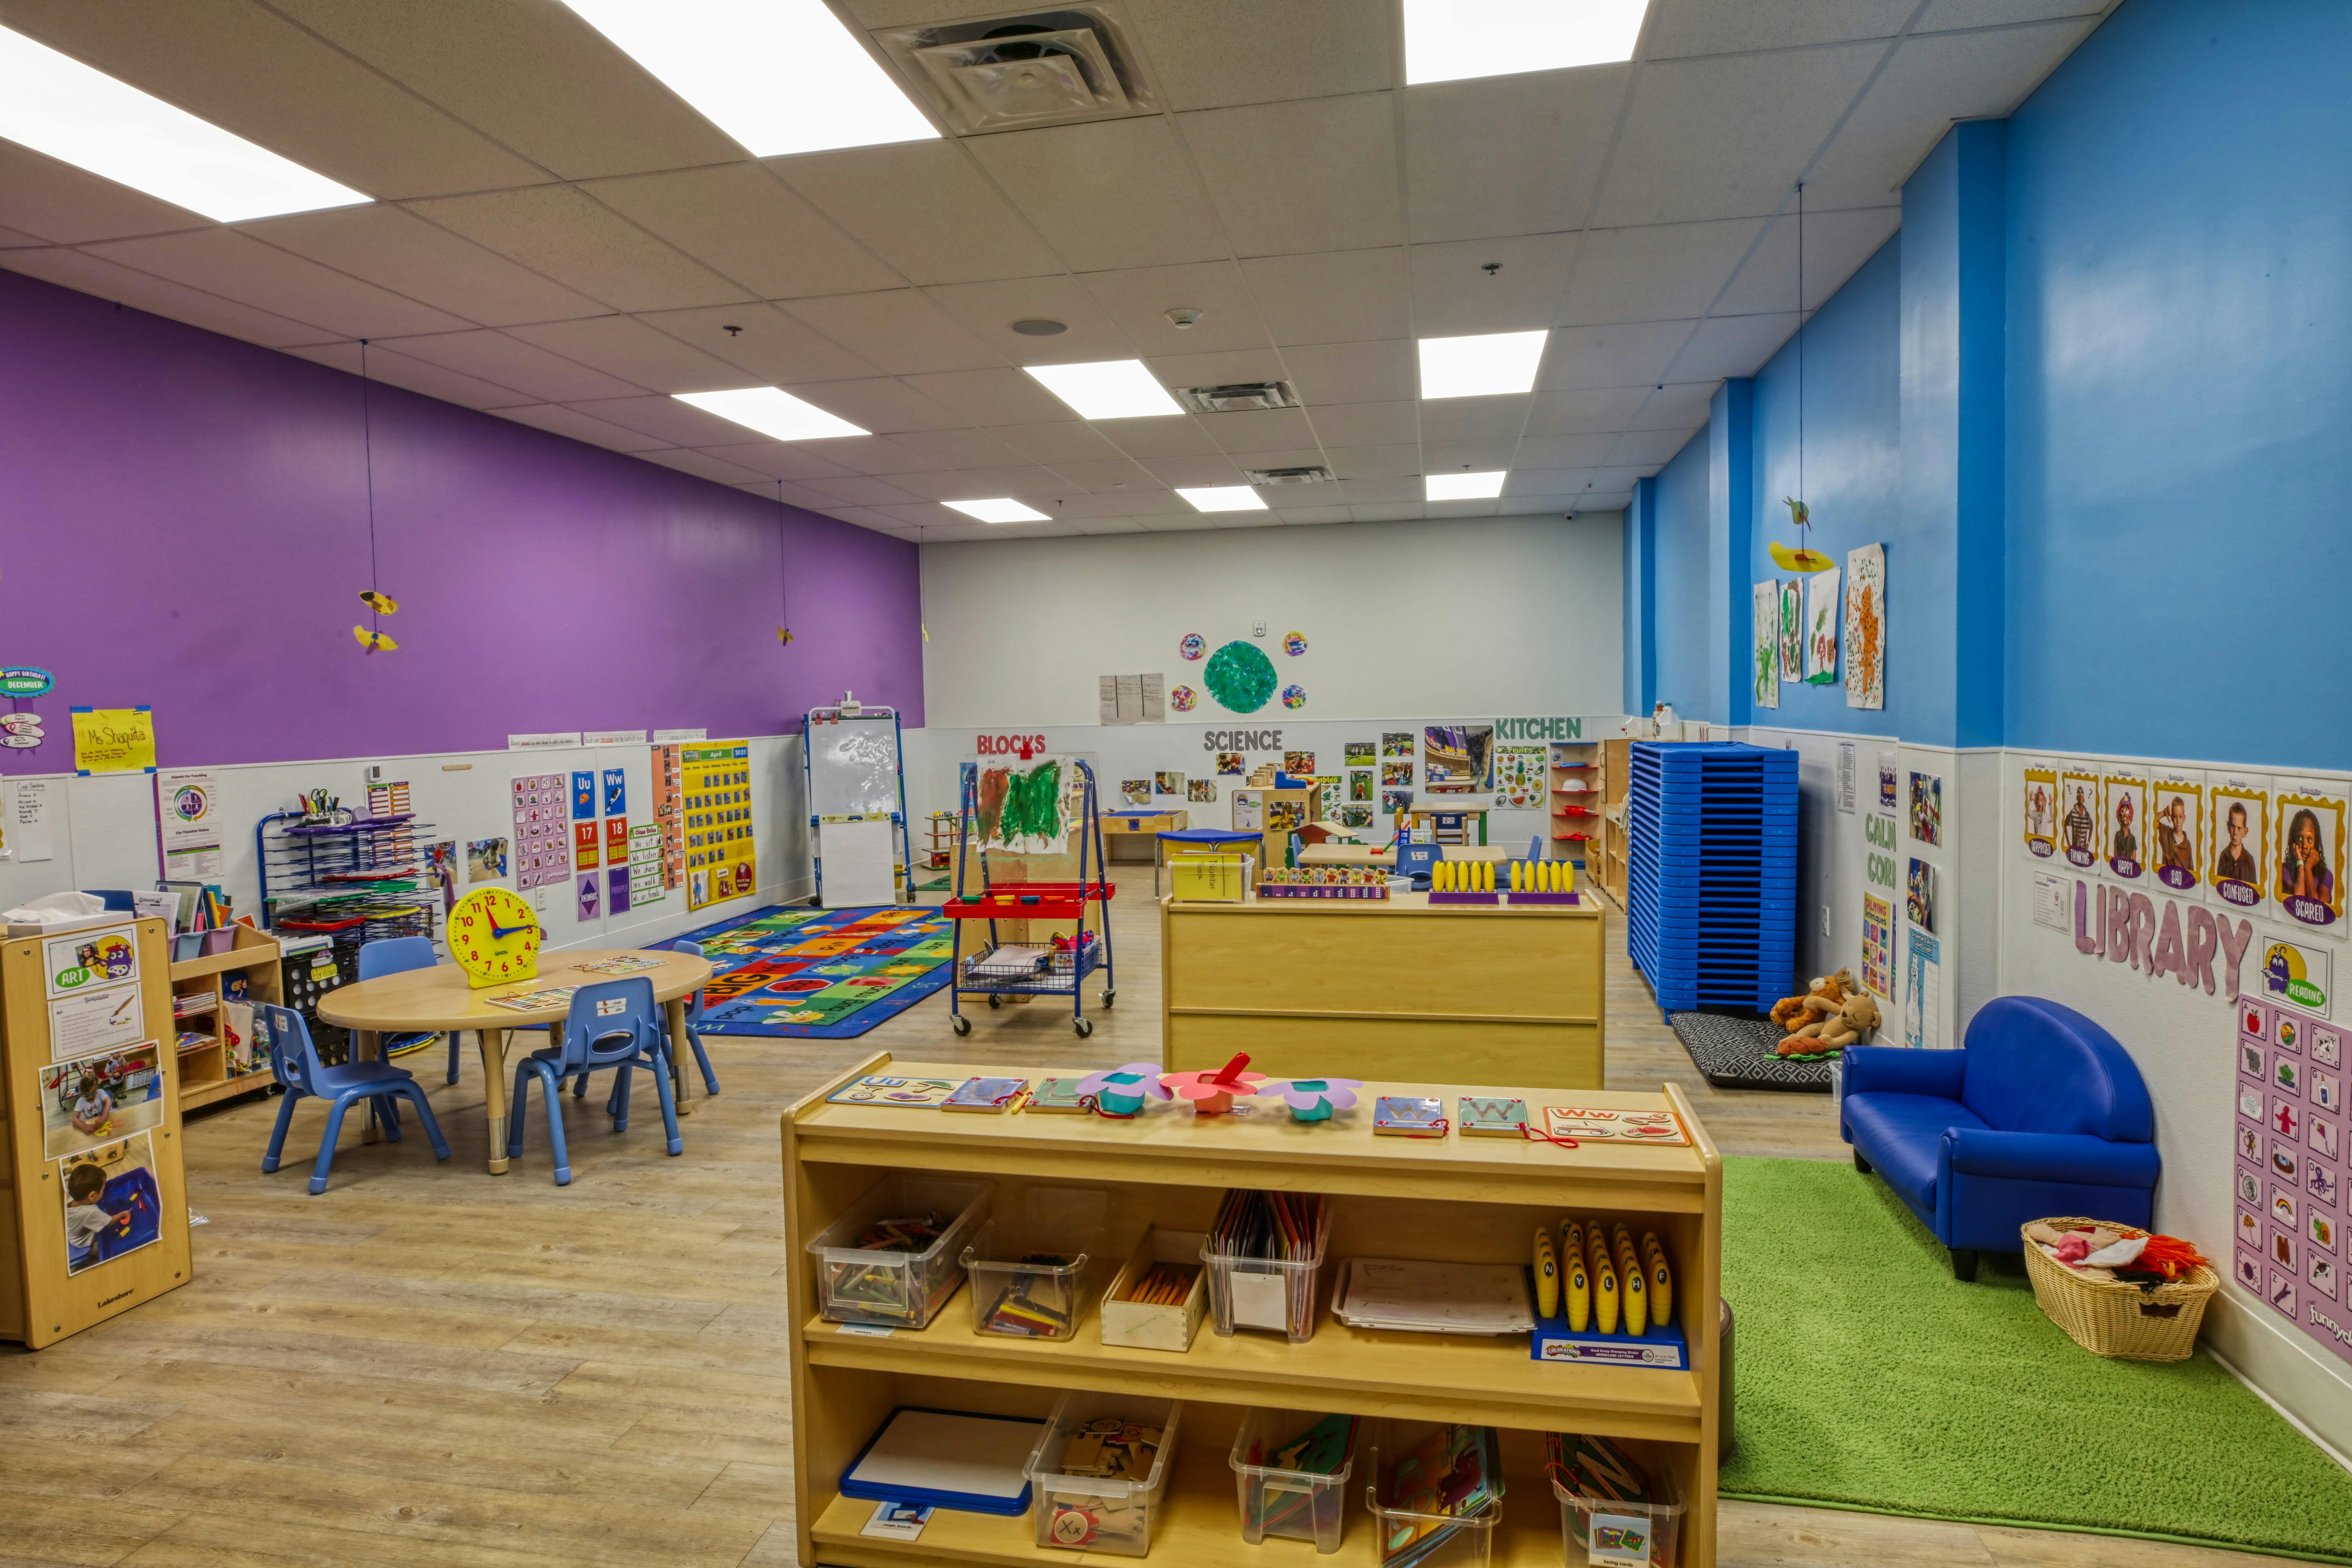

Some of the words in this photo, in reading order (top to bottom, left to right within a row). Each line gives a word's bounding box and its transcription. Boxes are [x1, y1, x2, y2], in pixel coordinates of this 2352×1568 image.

[22, 671, 46, 680] BIRTHDAY!
[1495, 718, 1581, 739] KITCHEN
[88, 729, 103, 745] Ms
[1204, 731, 1282, 751] SCIENCE
[977, 735, 1045, 754] BLOCKS
[578, 777, 590, 790] Uu
[606, 774, 622, 786] Ww
[581, 827, 592, 840] 17
[612, 822, 623, 835] 18
[1865, 813, 1896, 852] CALM
[2031, 840, 2050, 855] SURPRISED
[632, 853, 639, 862] We
[643, 851, 656, 860] listen
[2070, 849, 2089, 865] THINKING
[633, 866, 640, 875] We
[644, 864, 655, 873] share
[2118, 860, 2133, 875] HAPPY
[1209, 860, 1218, 890] Number
[2171, 869, 2182, 885] SAD
[645, 876, 656, 886] walk
[611, 883, 628, 895] PURPLE
[648, 889, 659, 898] friends
[2223, 882, 2253, 904] CONFUSED
[484, 895, 497, 906] 12
[581, 892, 598, 903] RHOMBUS
[471, 903, 481, 913] 11
[505, 899, 510, 908] 1
[1865, 898, 1886, 916] CALMING
[518, 909, 525, 919] 2
[2296, 899, 2323, 922] SCARED
[461, 916, 473, 927] 10
[1865, 908, 1886, 926] Techniques
[526, 924, 533, 934] 3
[462, 935, 469, 945] 9
[1912, 931, 1925, 942] Snowman
[2075, 880, 2252, 1002] LIBRARY
[524, 942, 531, 951] 4
[918, 942, 947, 950] bun
[471, 951, 478, 961] 8
[517, 955, 523, 965] 5
[485, 961, 492, 971] 7
[502, 962, 508, 972] 6
[62, 969, 84, 985] ART
[704, 974, 771, 994] BIG
[854, 986, 892, 998] mug
[2290, 984, 2322, 1004] READING
[818, 1000, 865, 1011] bug
[714, 1006, 754, 1019] pop
[2312, 1027, 2317, 1035] C
[2312, 1070, 2317, 1078] G
[864, 1077, 904, 1086] Uu
[1387, 1103, 1431, 1119] W
[1470, 1101, 1514, 1120] W
[1556, 1109, 1615, 1118] Ww
[2311, 1118, 2316, 1126] K
[2240, 1125, 2245, 1134] M
[2239, 1169, 2243, 1178] Q
[2273, 1187, 2277, 1195] R
[2239, 1207, 2243, 1216] U
[2310, 1208, 2313, 1216] S
[2239, 1250, 2243, 1258] Y
[2310, 1251, 2315, 1260] W
[1576, 1277, 1582, 1285] Y
[1606, 1279, 1611, 1287] L
[1633, 1280, 1640, 1288] H
[98, 1289, 134, 1308] Lakeshore
[1548, 1347, 1581, 1355] COLORATIONS
[1059, 1520, 1080, 1535] Xx
